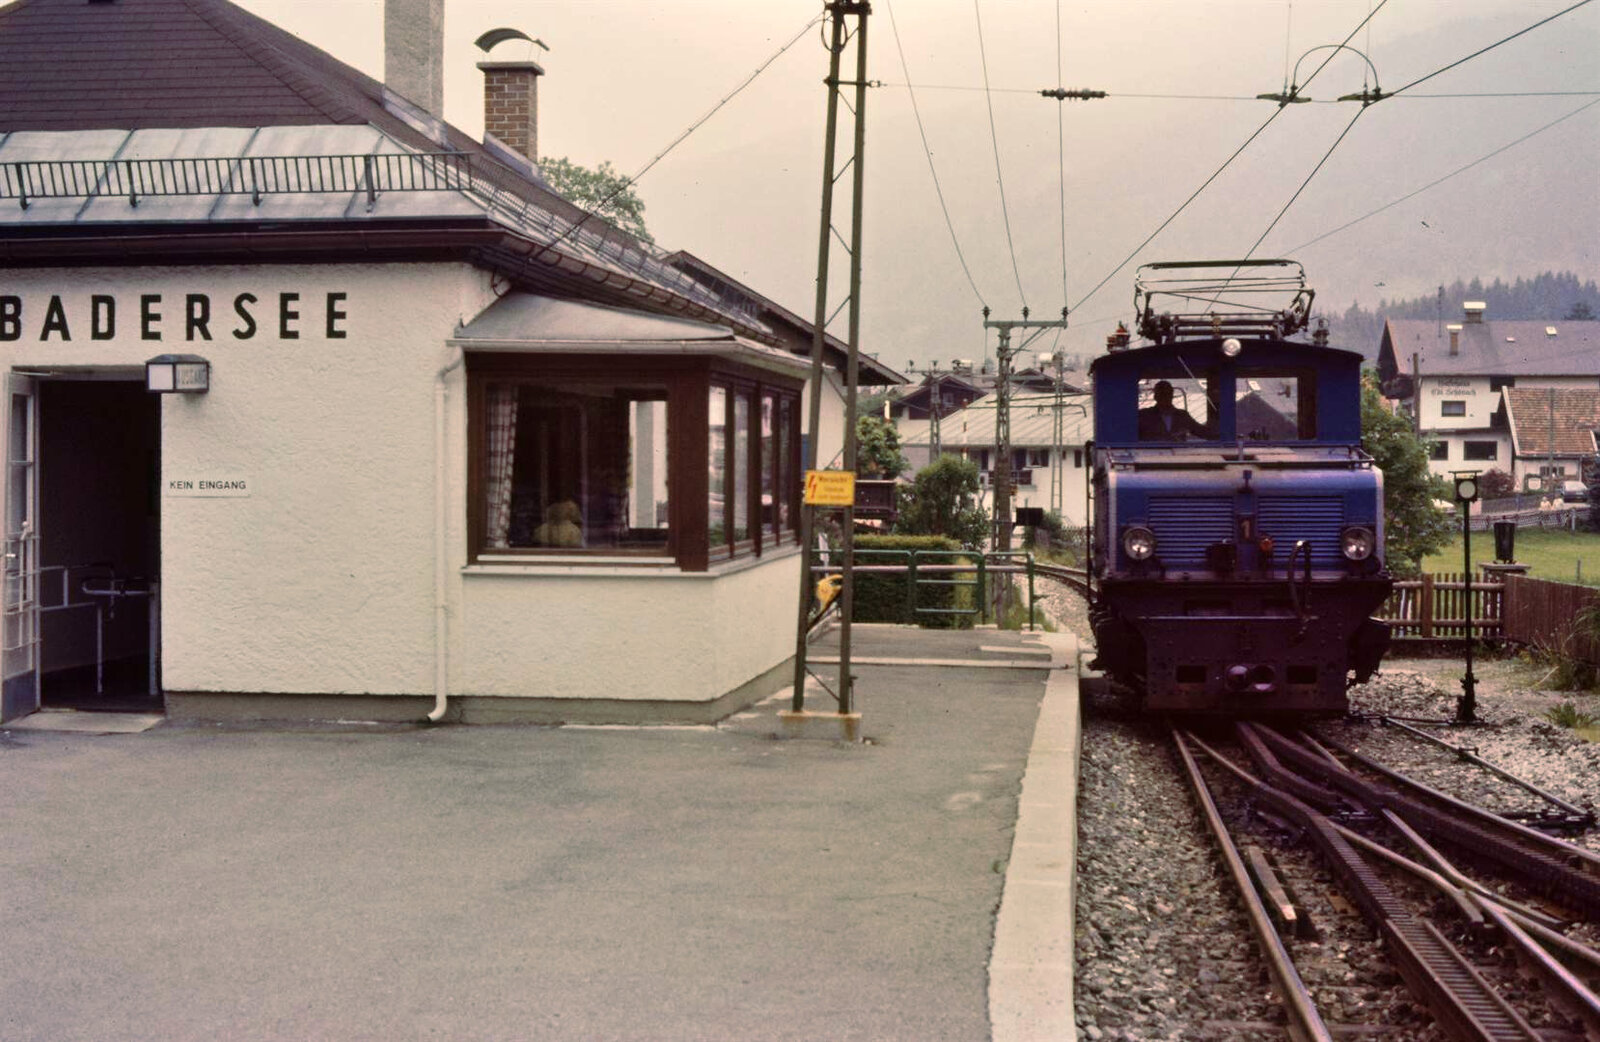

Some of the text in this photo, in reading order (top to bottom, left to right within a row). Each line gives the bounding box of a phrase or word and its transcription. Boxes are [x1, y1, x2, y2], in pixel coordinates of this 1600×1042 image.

[0, 292, 347, 342] BADERSEE
[169, 480, 247, 490] KEIN EINGANG
[1240, 520, 1250, 539] 1
